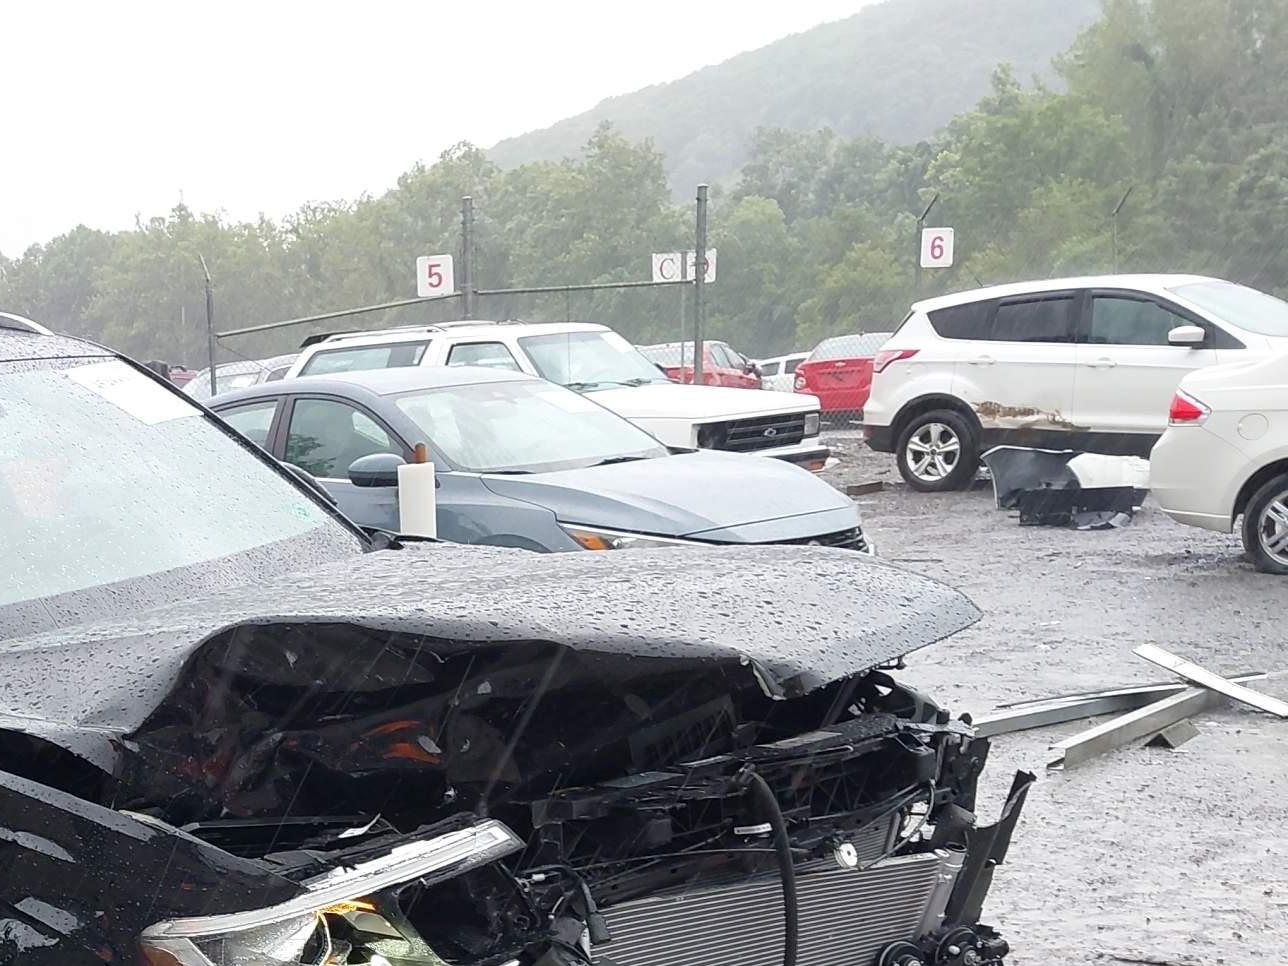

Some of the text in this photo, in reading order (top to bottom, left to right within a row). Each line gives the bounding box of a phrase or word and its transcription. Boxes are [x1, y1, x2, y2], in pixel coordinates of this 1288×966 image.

[930, 235, 945, 260] 6
[428, 263, 443, 288] 5
[659, 257, 676, 280] C
